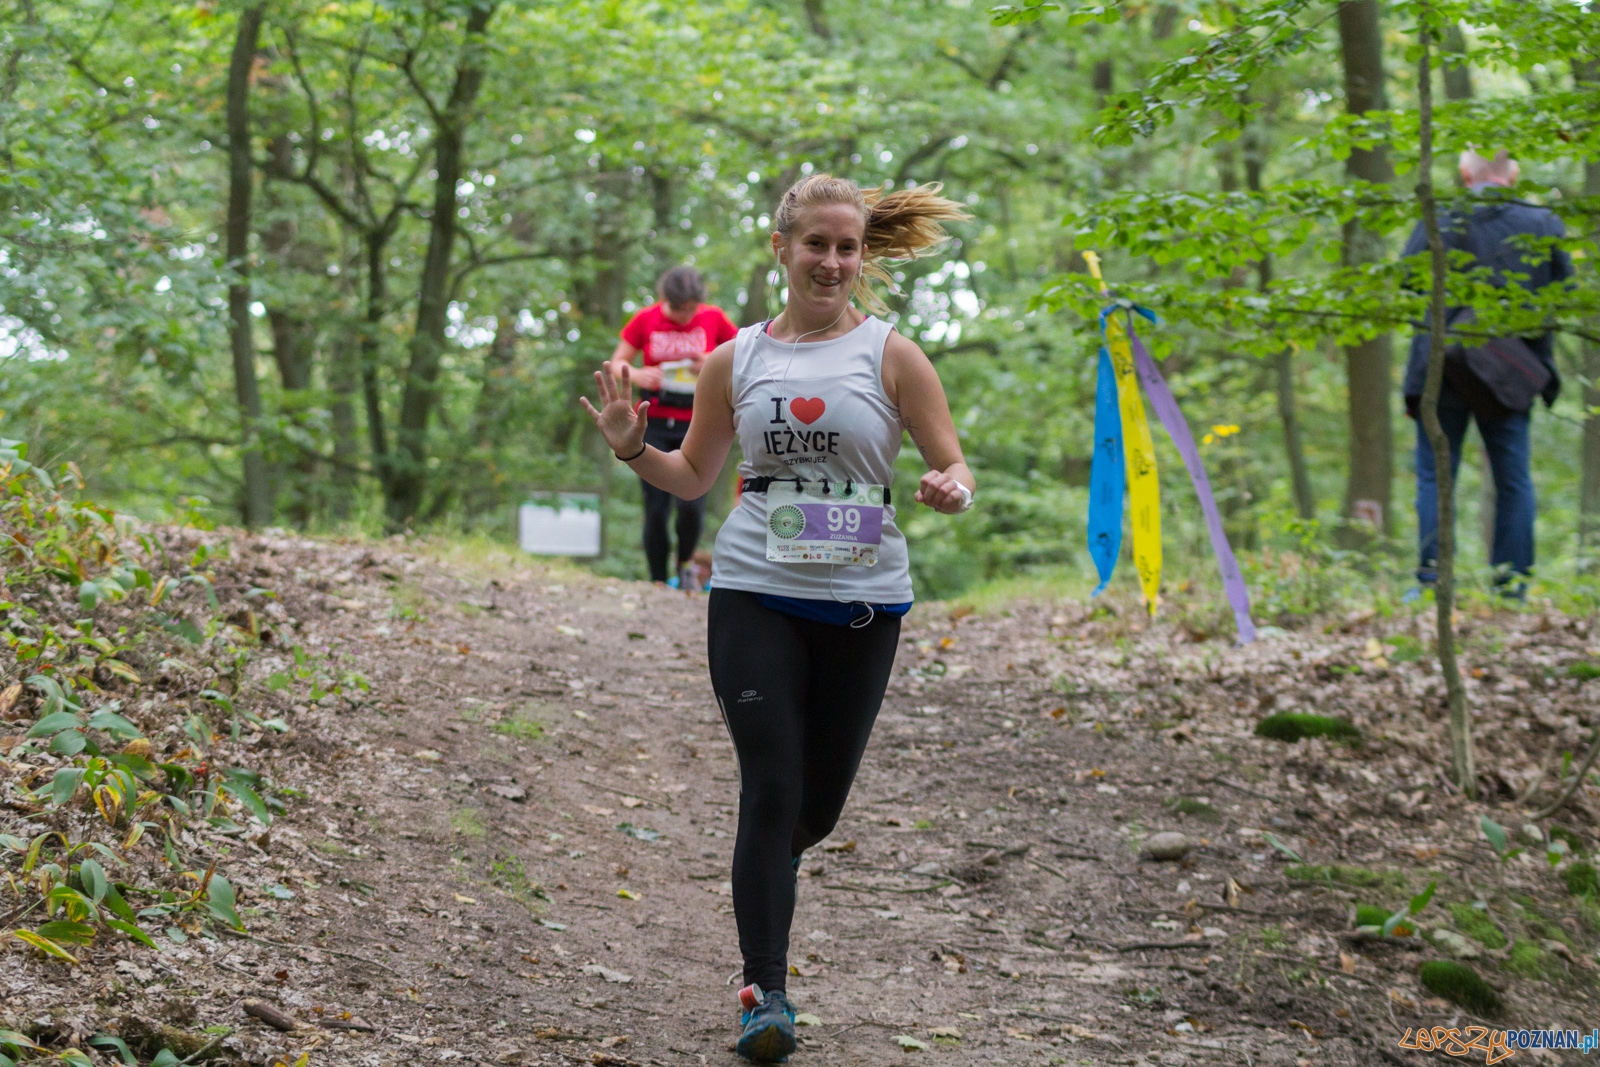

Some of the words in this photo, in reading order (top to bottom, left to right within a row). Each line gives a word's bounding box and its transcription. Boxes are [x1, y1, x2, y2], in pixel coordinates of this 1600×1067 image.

[770, 397, 787, 424] I
[827, 507, 861, 533] 99
[829, 533, 858, 541] ZUZANNA
